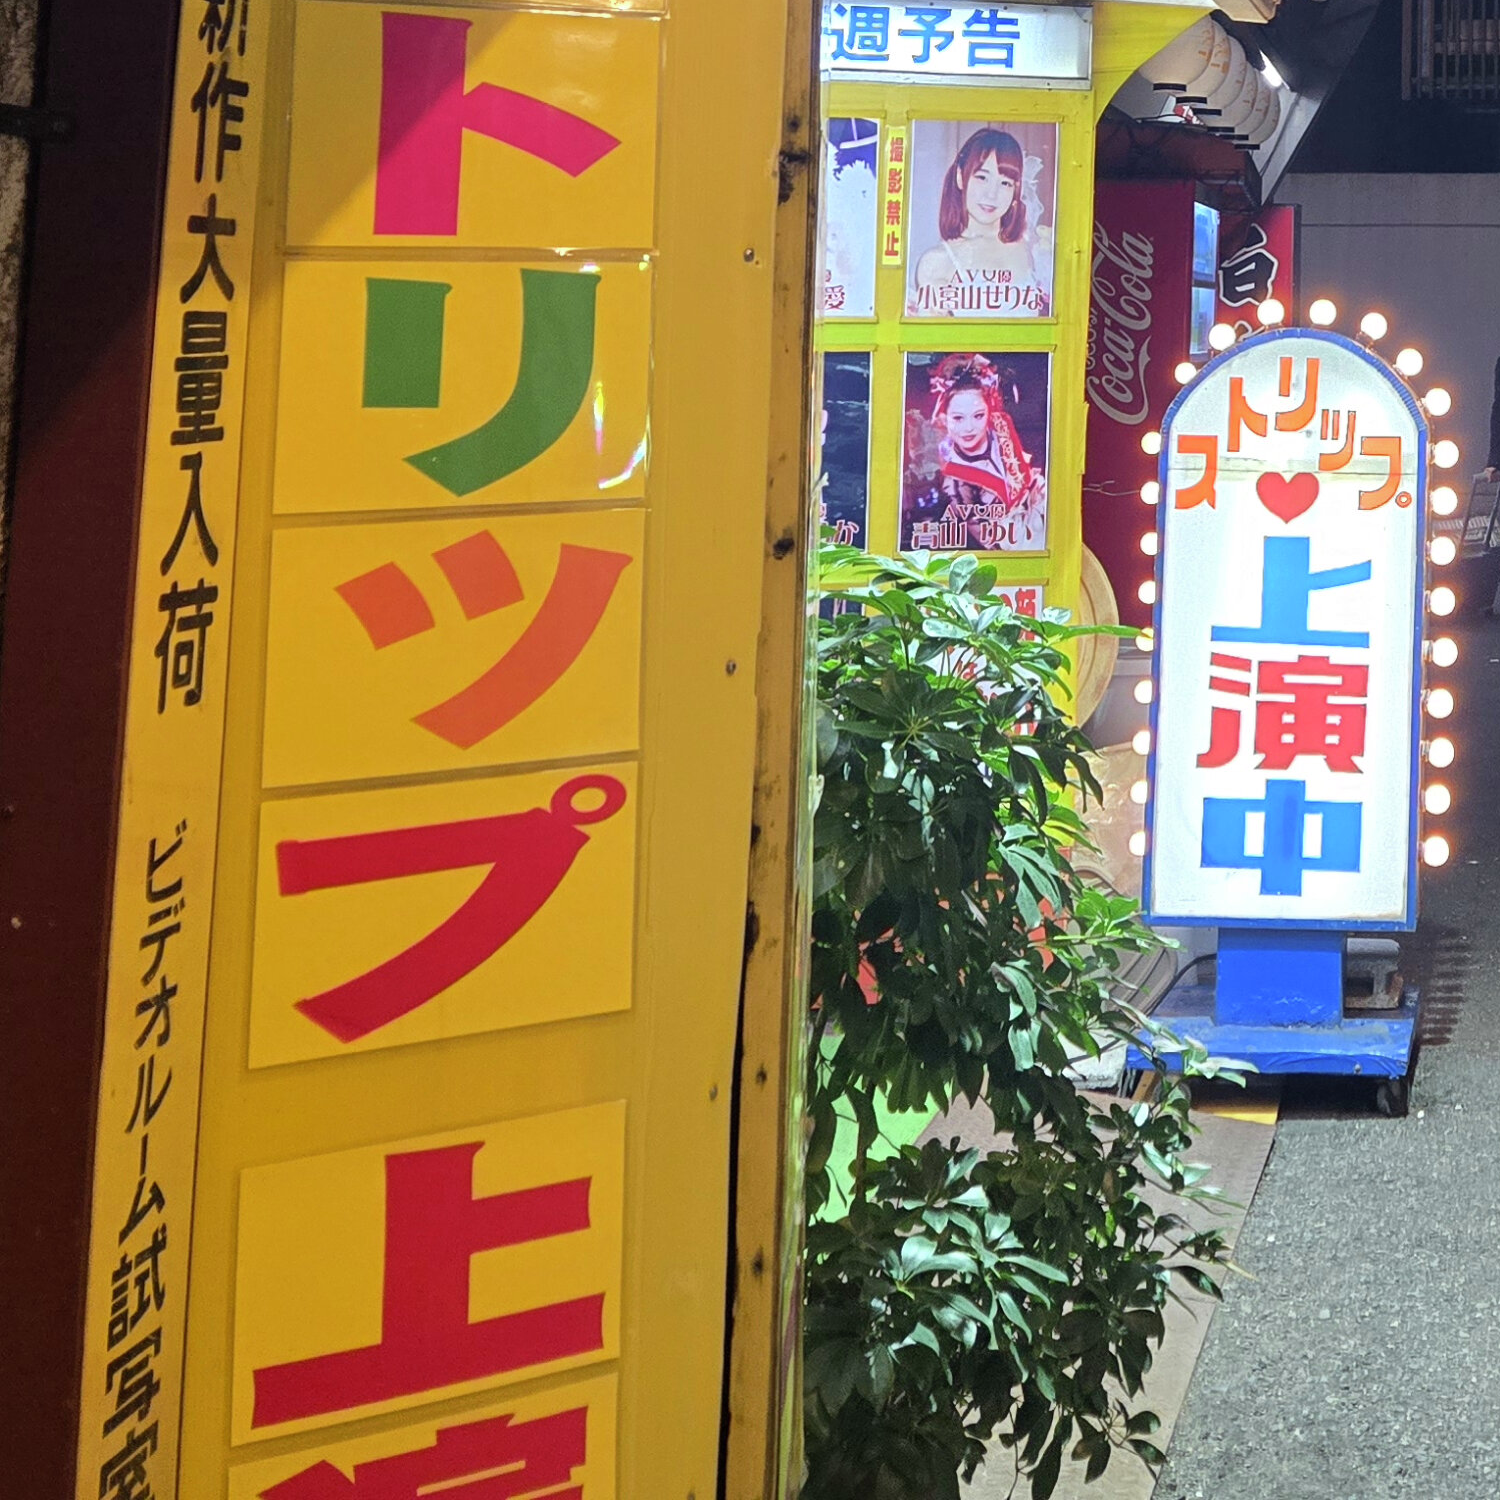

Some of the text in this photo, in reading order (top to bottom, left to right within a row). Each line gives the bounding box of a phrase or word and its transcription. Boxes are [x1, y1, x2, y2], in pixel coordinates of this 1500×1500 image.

[823, 3, 1020, 69] 週予告
[917, 284, 1043, 311] 小宮山せりな
[1087, 220, 1154, 426] Coca-Cola
[1174, 356, 1412, 511] ストリップ
[1195, 536, 1372, 897] 上演中
